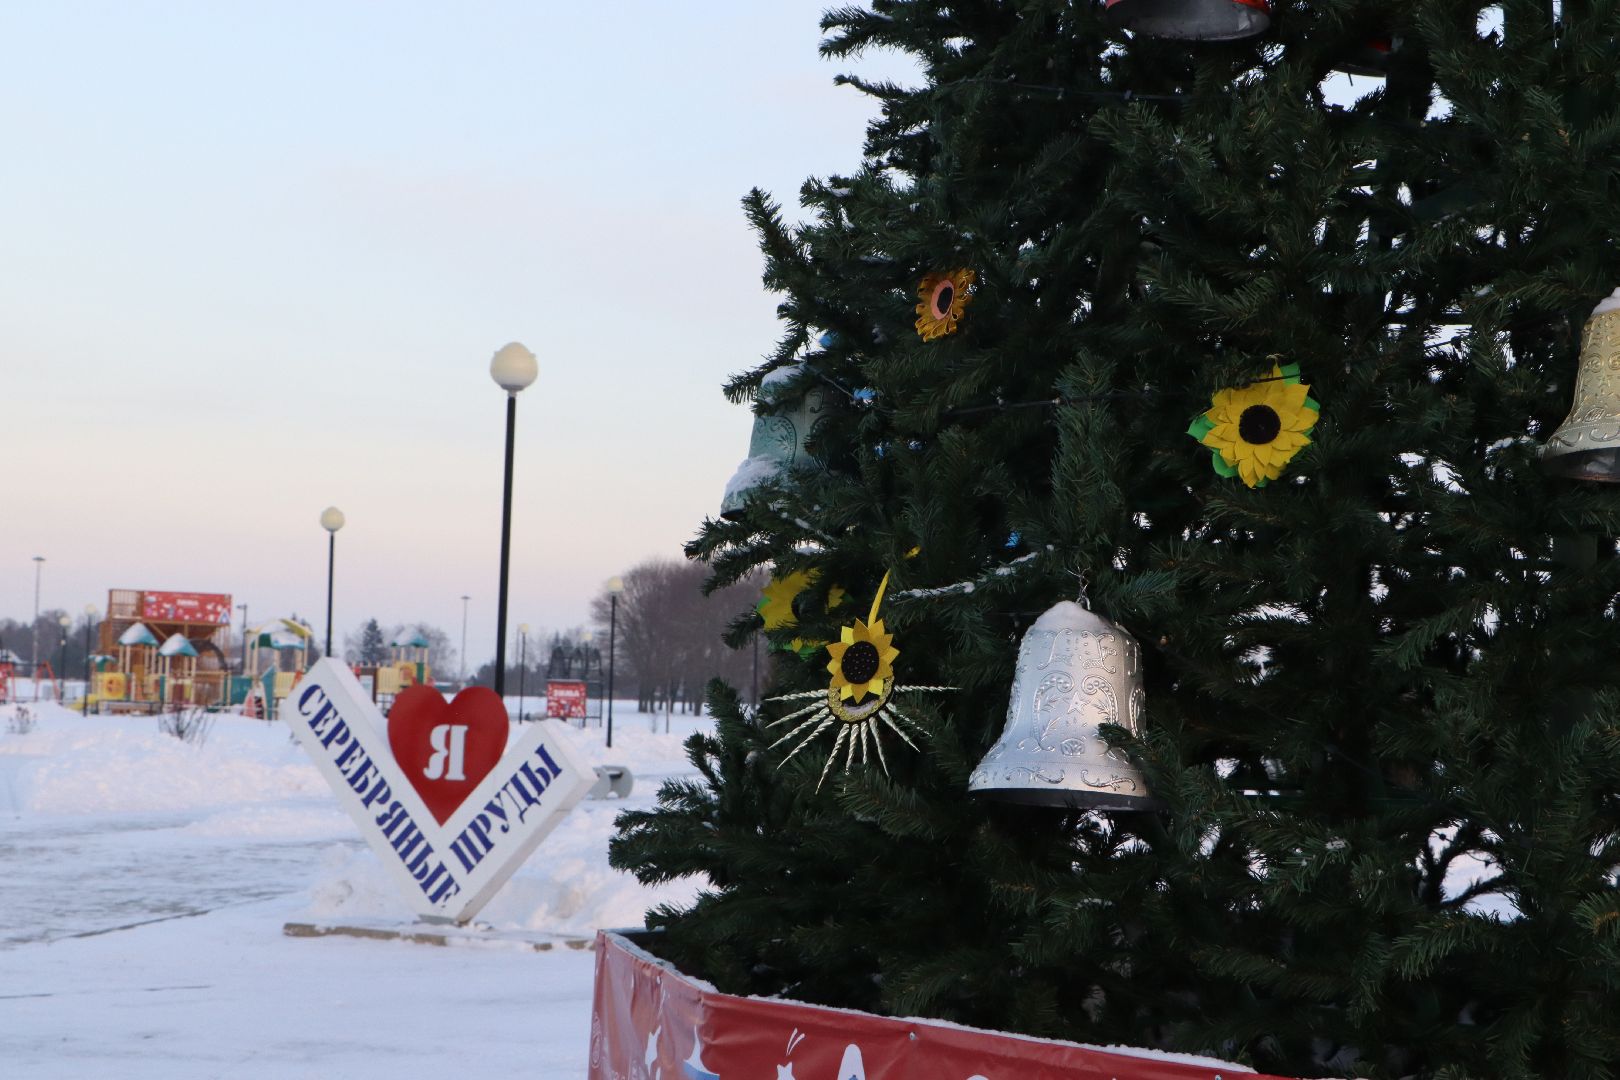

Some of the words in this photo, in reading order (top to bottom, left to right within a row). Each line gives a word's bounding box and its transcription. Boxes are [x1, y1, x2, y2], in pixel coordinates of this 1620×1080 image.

[297, 684, 461, 907] СЕРЕБРЯНЫЕ
[423, 724, 468, 781] Я
[449, 743, 563, 874] ПРУДЫ
